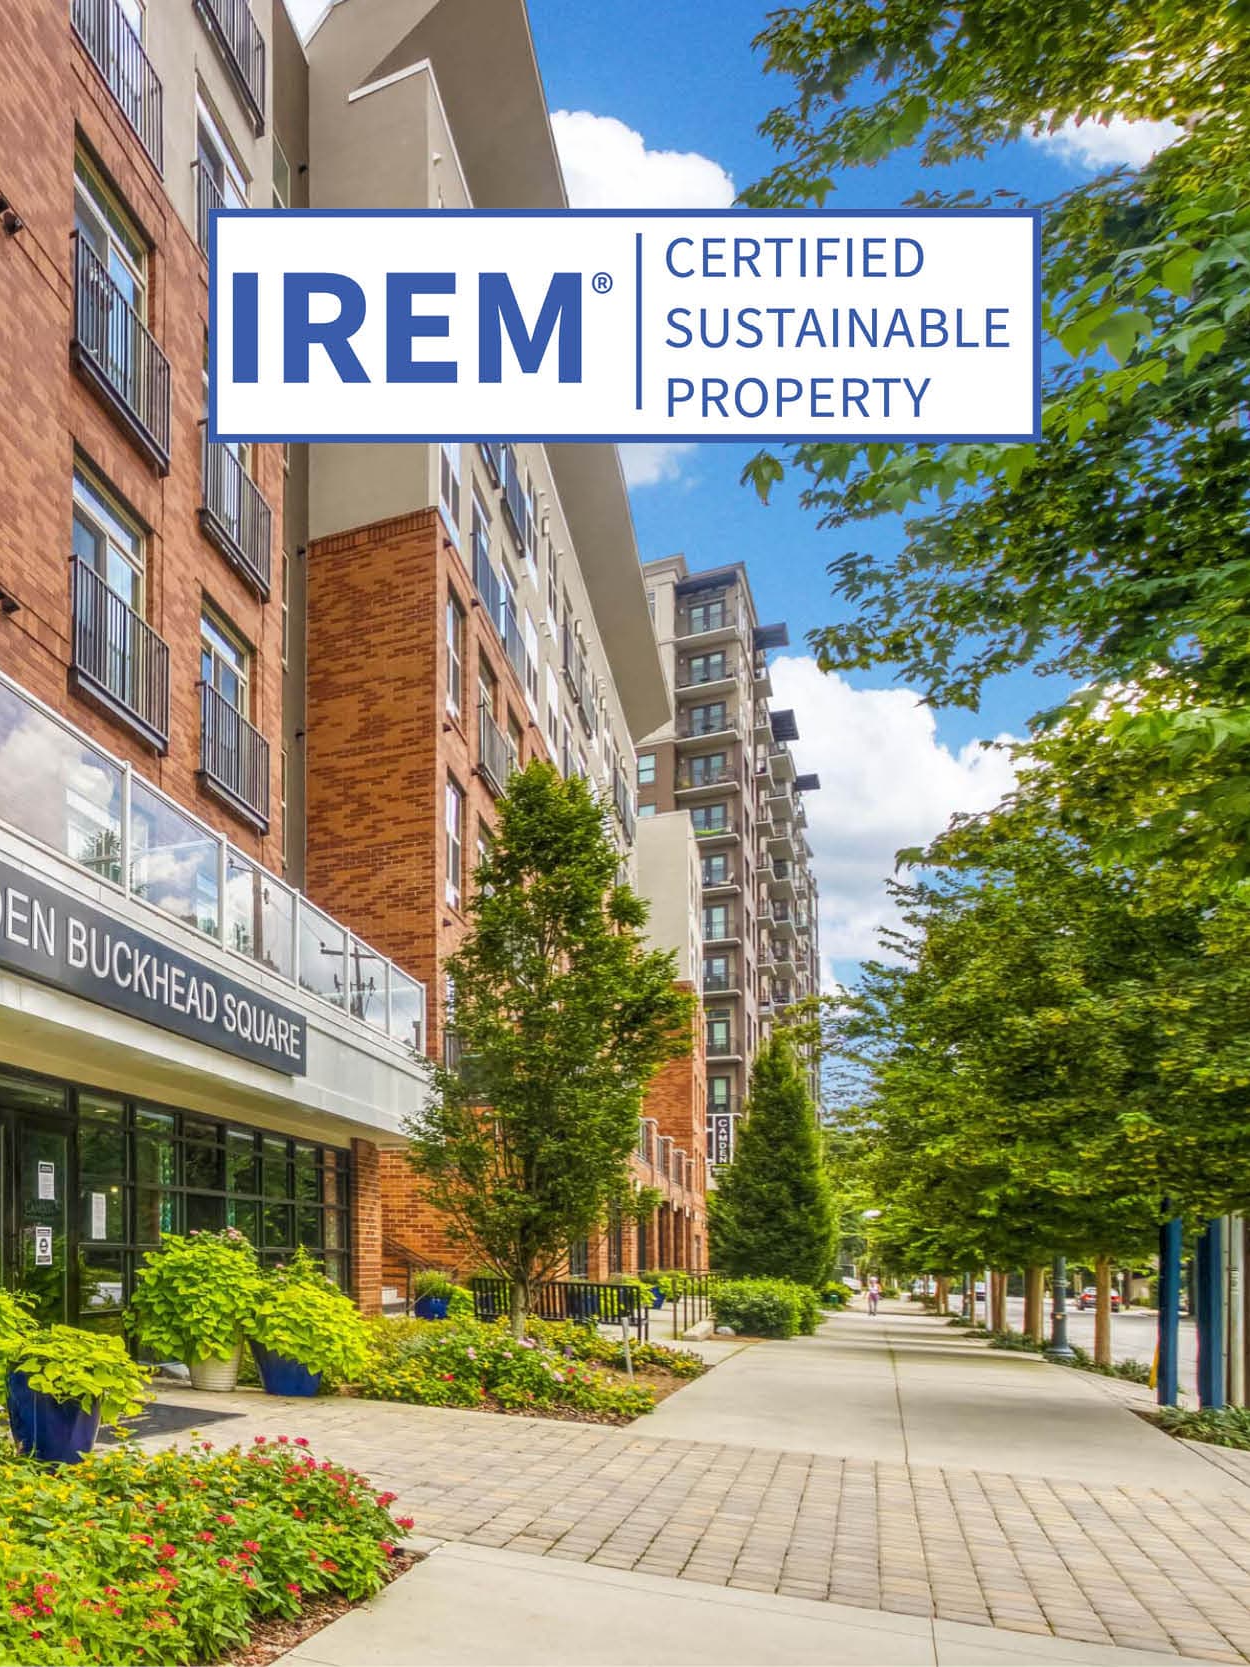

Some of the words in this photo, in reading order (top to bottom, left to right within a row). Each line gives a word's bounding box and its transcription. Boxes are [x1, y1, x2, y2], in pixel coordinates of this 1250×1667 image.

[67, 917, 218, 1024] BUCKHEAD
[222, 992, 302, 1061] SQUARE
[718, 1119, 728, 1163] CAMDEN
